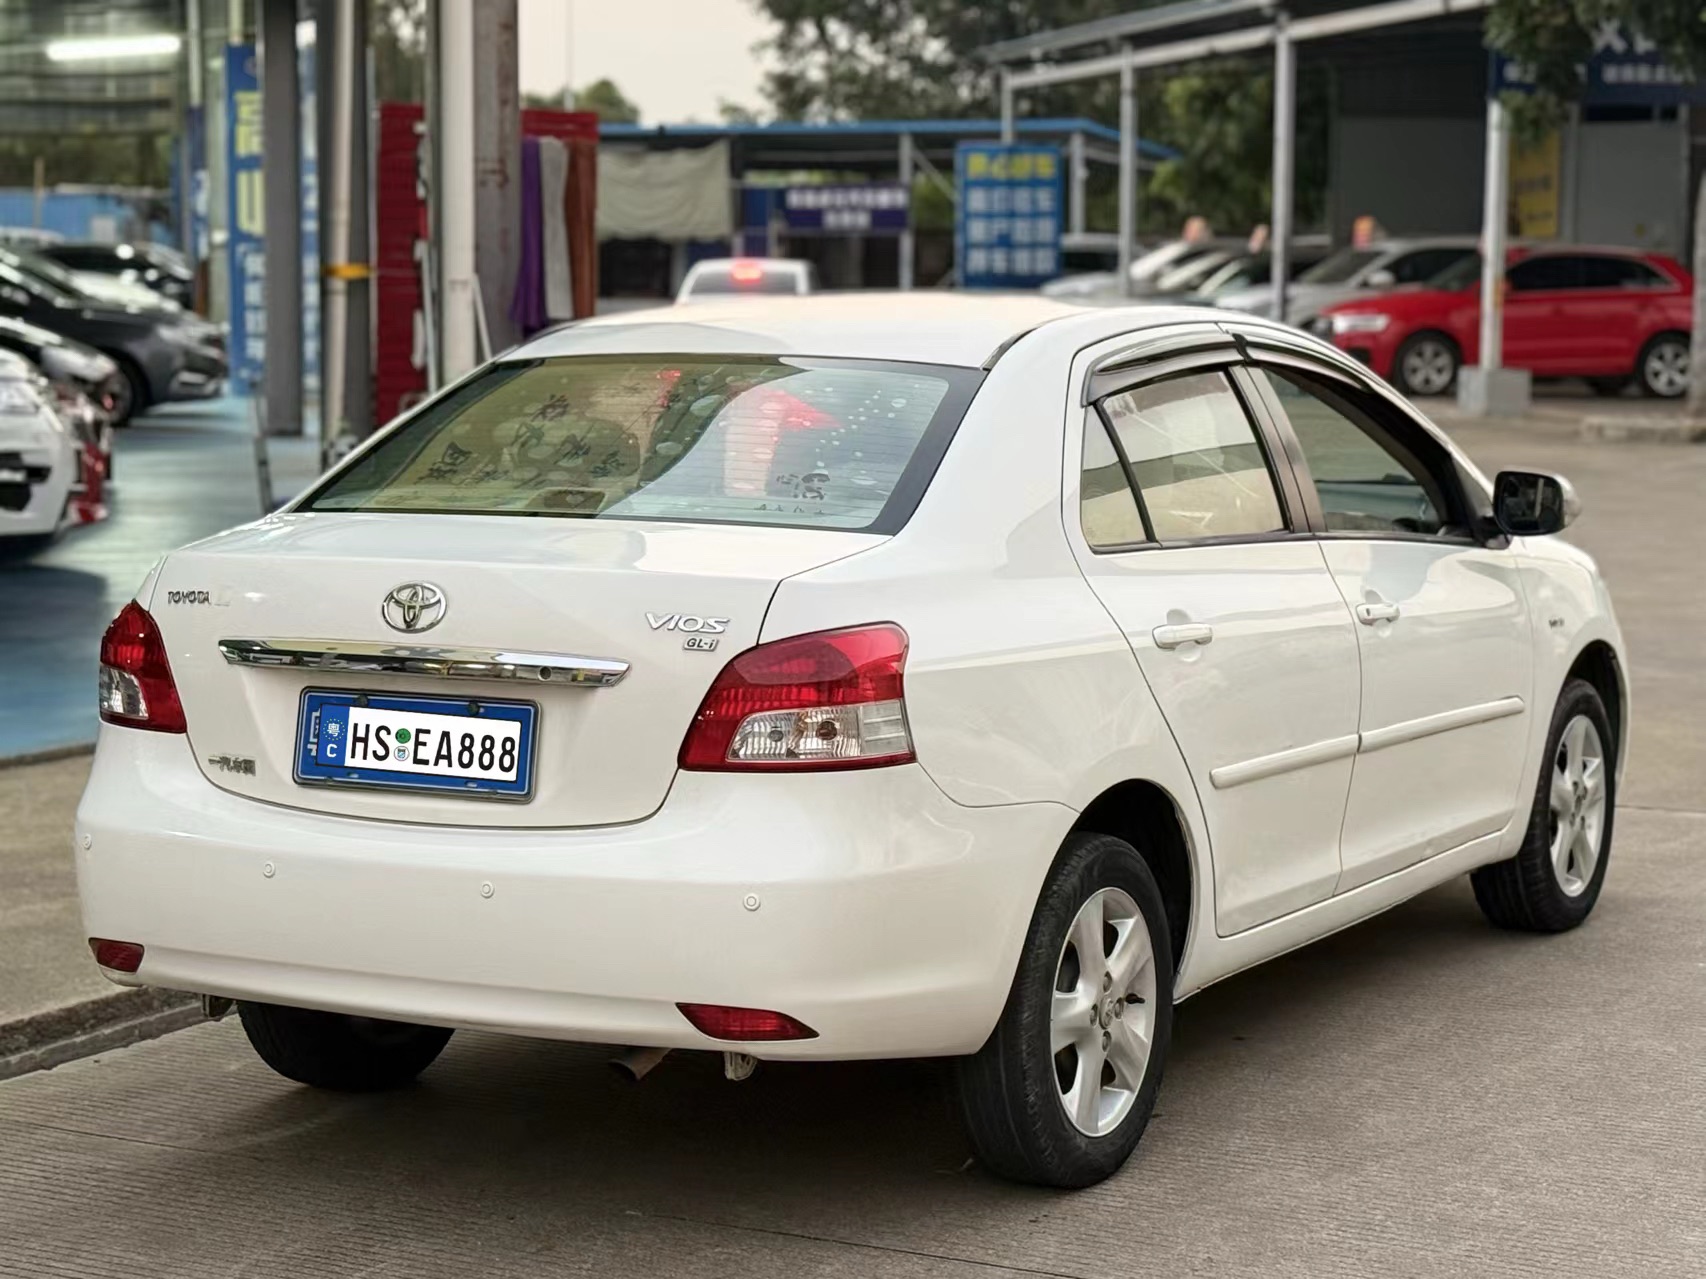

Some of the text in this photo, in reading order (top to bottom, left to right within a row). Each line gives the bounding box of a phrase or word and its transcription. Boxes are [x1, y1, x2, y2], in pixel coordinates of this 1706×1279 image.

[167, 590, 211, 605] TOYOTA
[646, 612, 730, 634] VIOS
[687, 638, 715, 649] GL-i
[326, 743, 338, 758] C
[350, 722, 391, 762] HS
[412, 728, 516, 773] EA888
